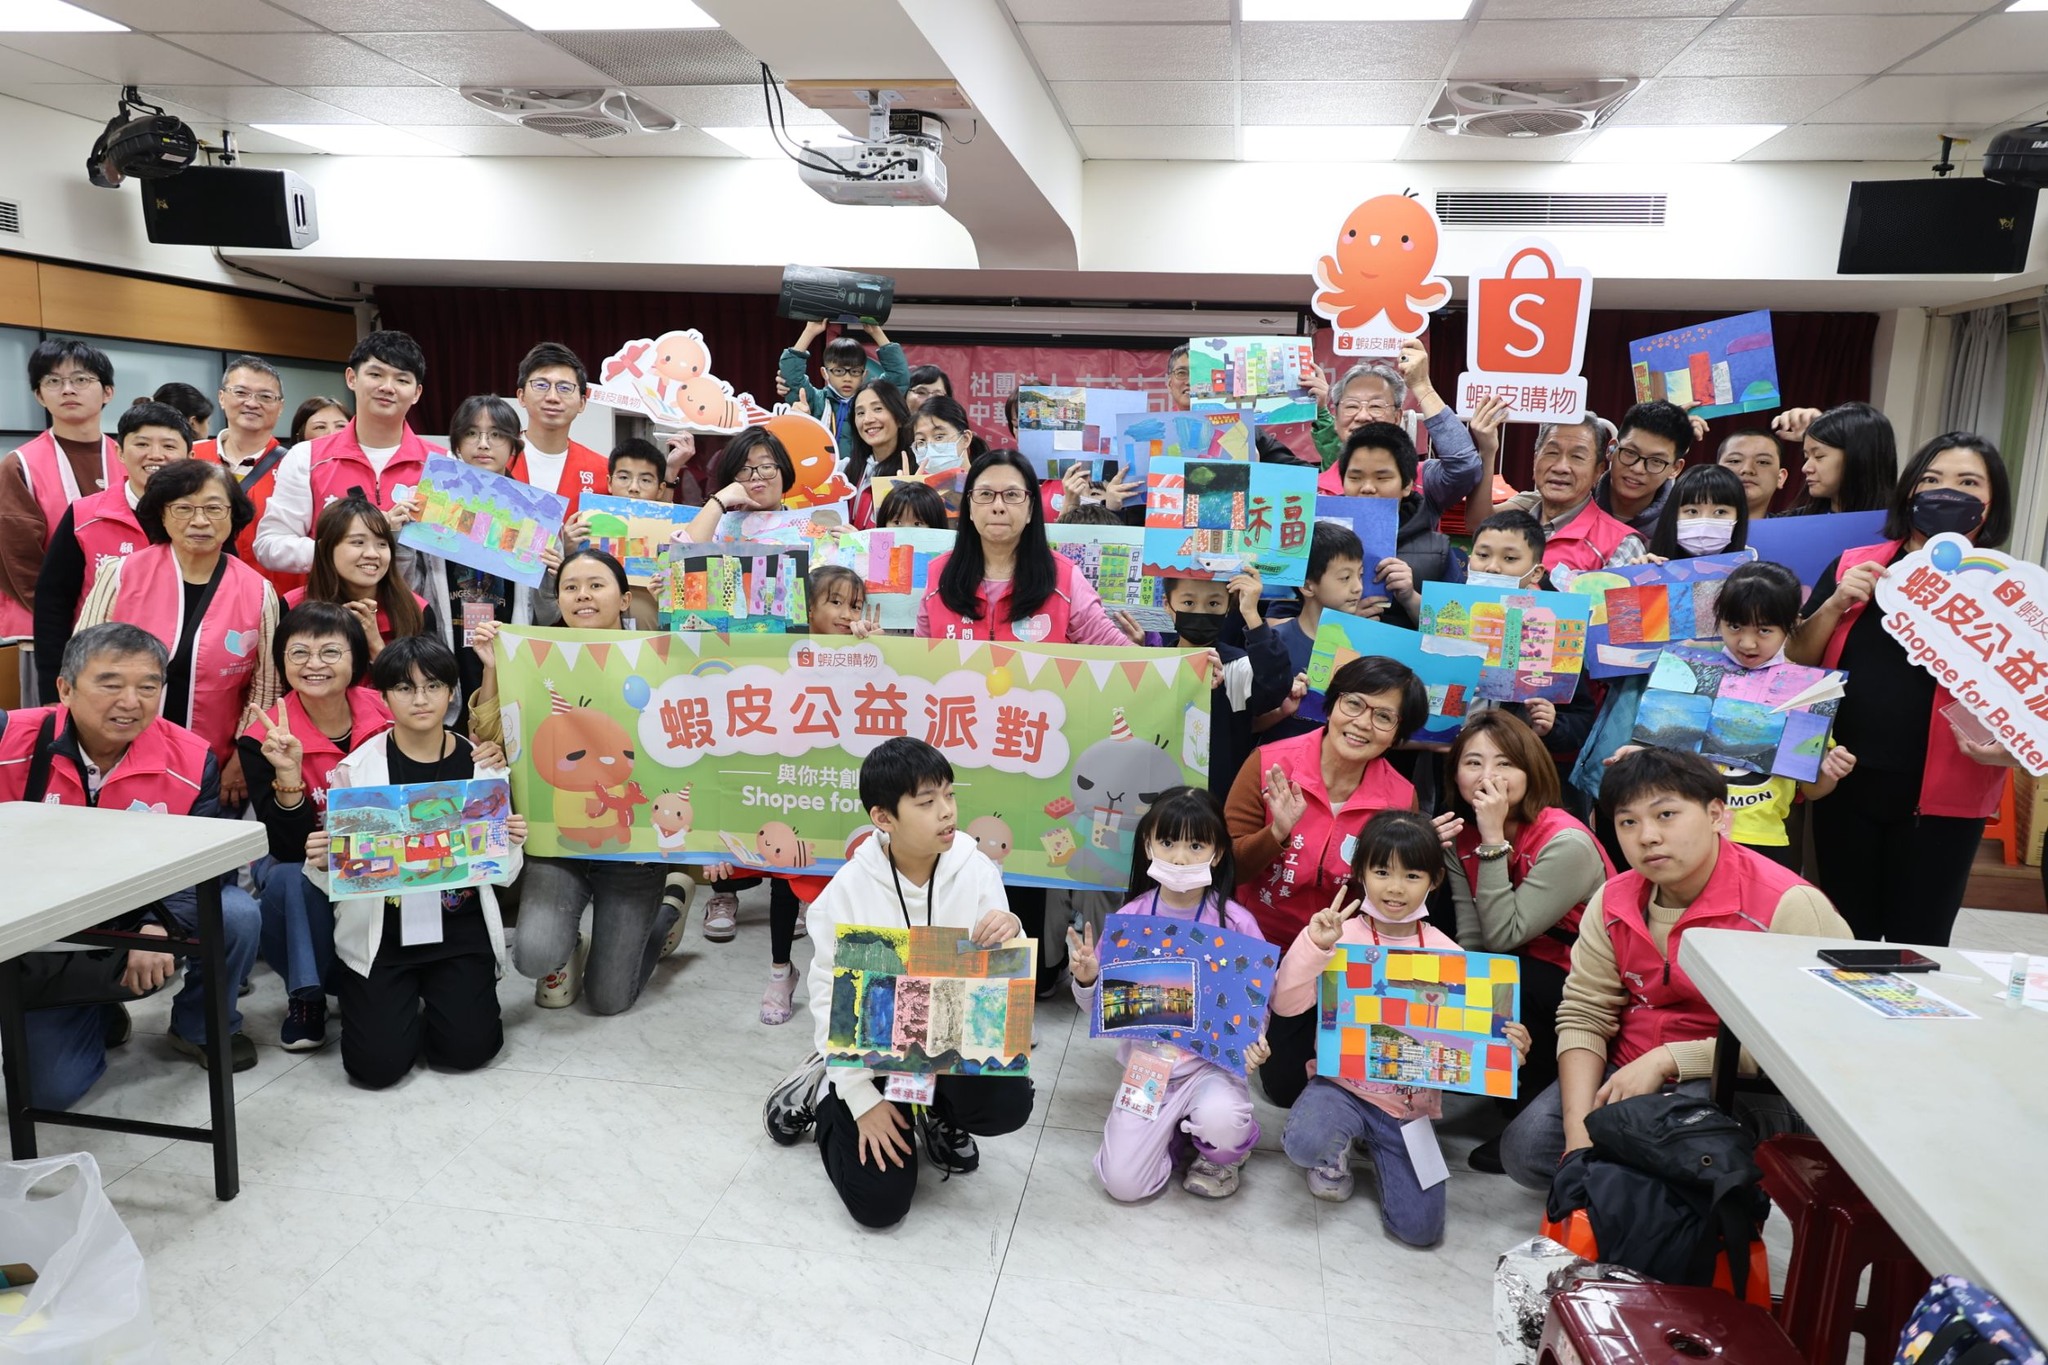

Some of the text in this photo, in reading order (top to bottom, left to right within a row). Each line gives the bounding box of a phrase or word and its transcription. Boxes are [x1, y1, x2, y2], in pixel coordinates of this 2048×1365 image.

[1504, 293, 1546, 358] S
[593, 389, 642, 409] 蝦皮購物
[1465, 383, 1577, 415] 蝦皮購物
[1247, 495, 1306, 549] 福
[817, 653, 878, 669] 蝦皮購物
[1887, 611, 1959, 684] Shopee
[1956, 679, 1990, 711] for
[658, 681, 1050, 764] 蝦皮公益派對
[742, 785, 863, 814] Shopee for
